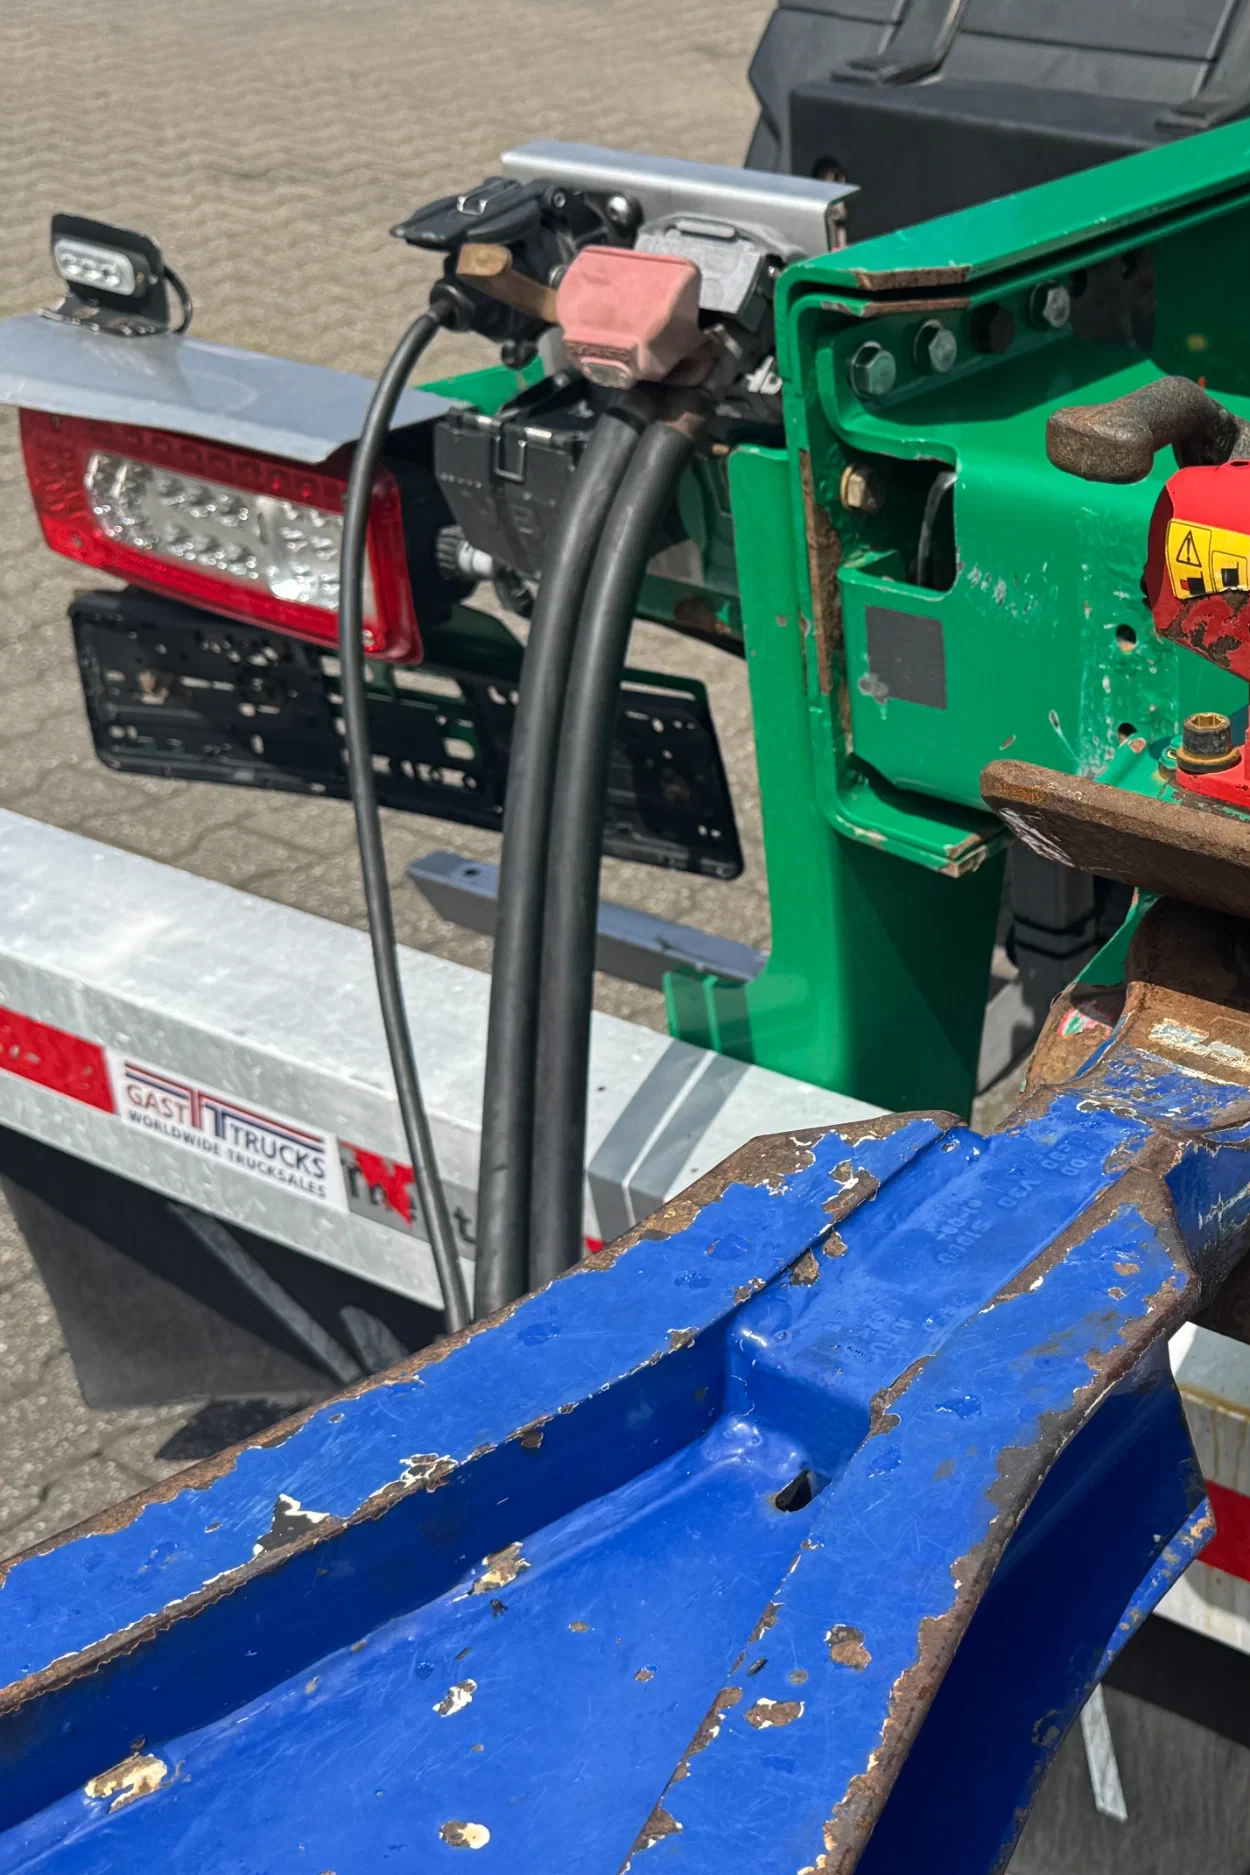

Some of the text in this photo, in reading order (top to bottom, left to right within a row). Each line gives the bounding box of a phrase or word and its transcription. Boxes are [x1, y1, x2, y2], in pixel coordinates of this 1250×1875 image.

[128, 1108, 327, 1199] WORLDWIDE TRUCKSALES
[229, 1122, 326, 1180] TRUCKS
